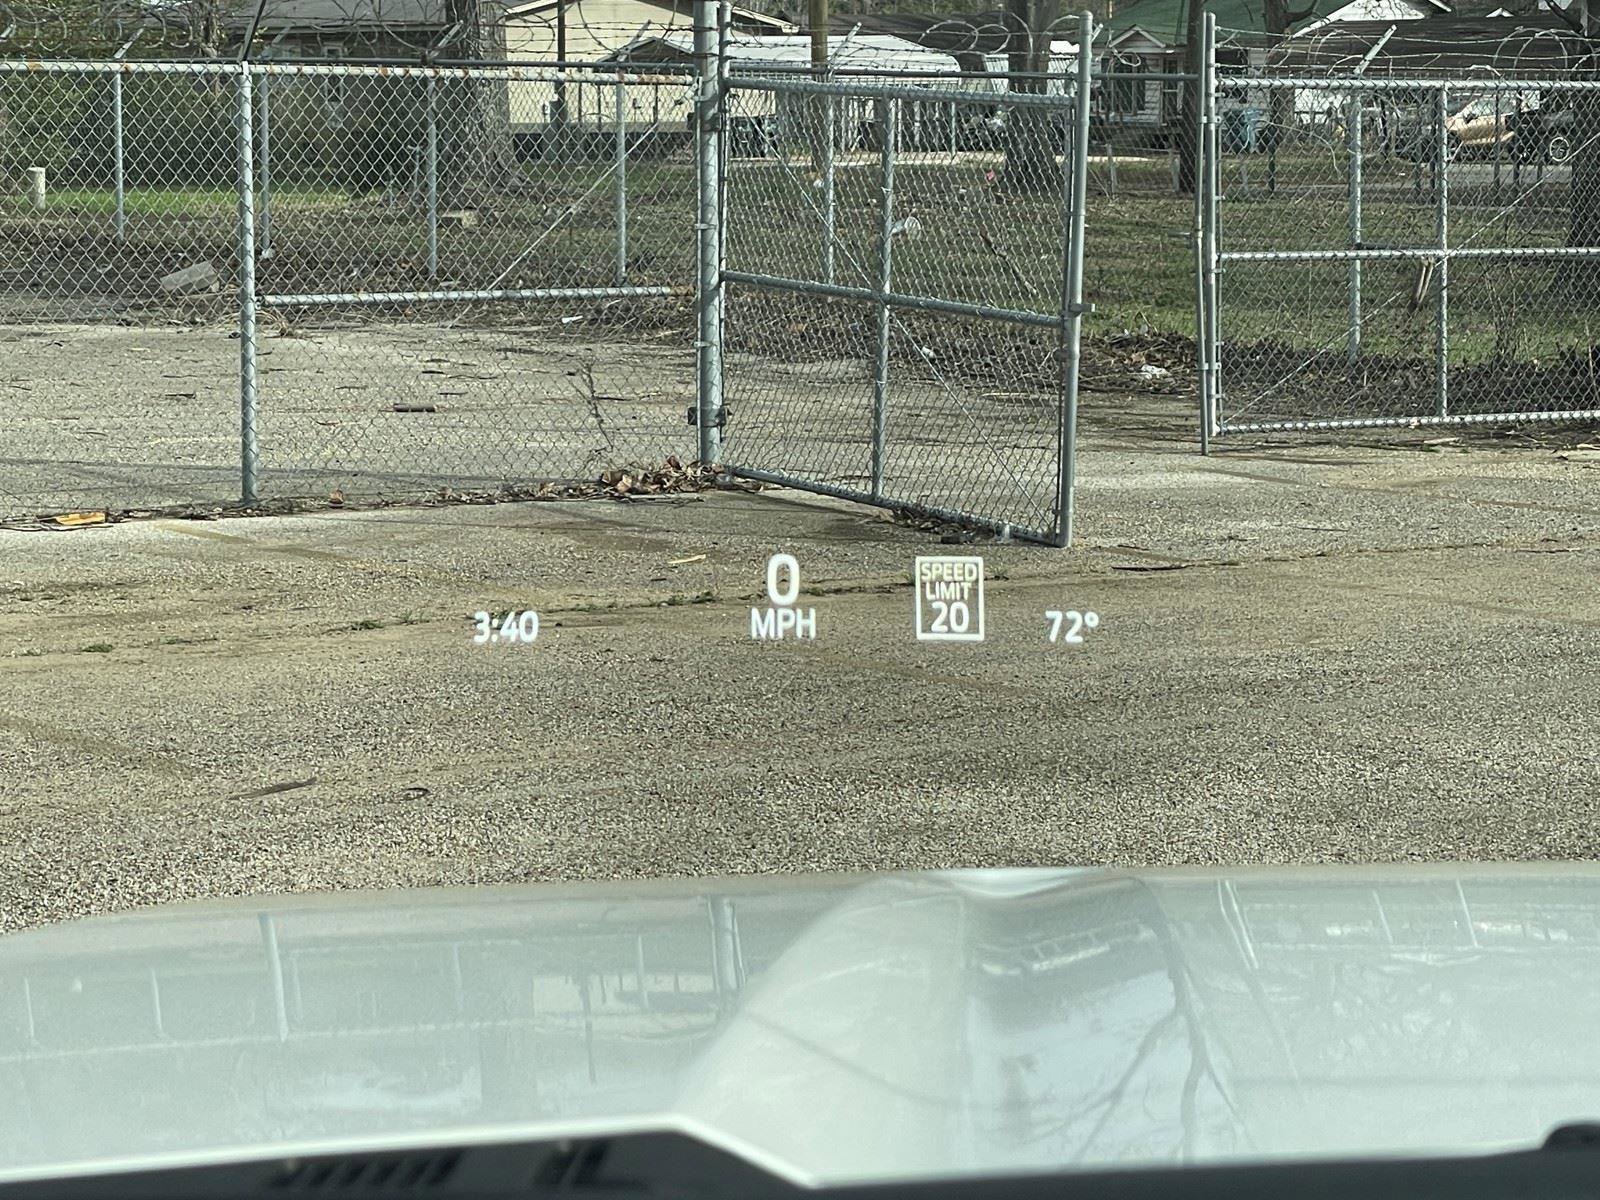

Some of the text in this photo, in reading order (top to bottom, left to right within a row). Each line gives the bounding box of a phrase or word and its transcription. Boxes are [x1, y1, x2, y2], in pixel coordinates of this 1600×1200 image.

[767, 554, 800, 606] 0
[921, 562, 977, 581] SPEED
[925, 582, 973, 601] LIMIT
[473, 610, 539, 643] 3:40
[750, 608, 816, 640] MPH
[931, 601, 970, 633] 20
[1045, 610, 1100, 643] 72°
